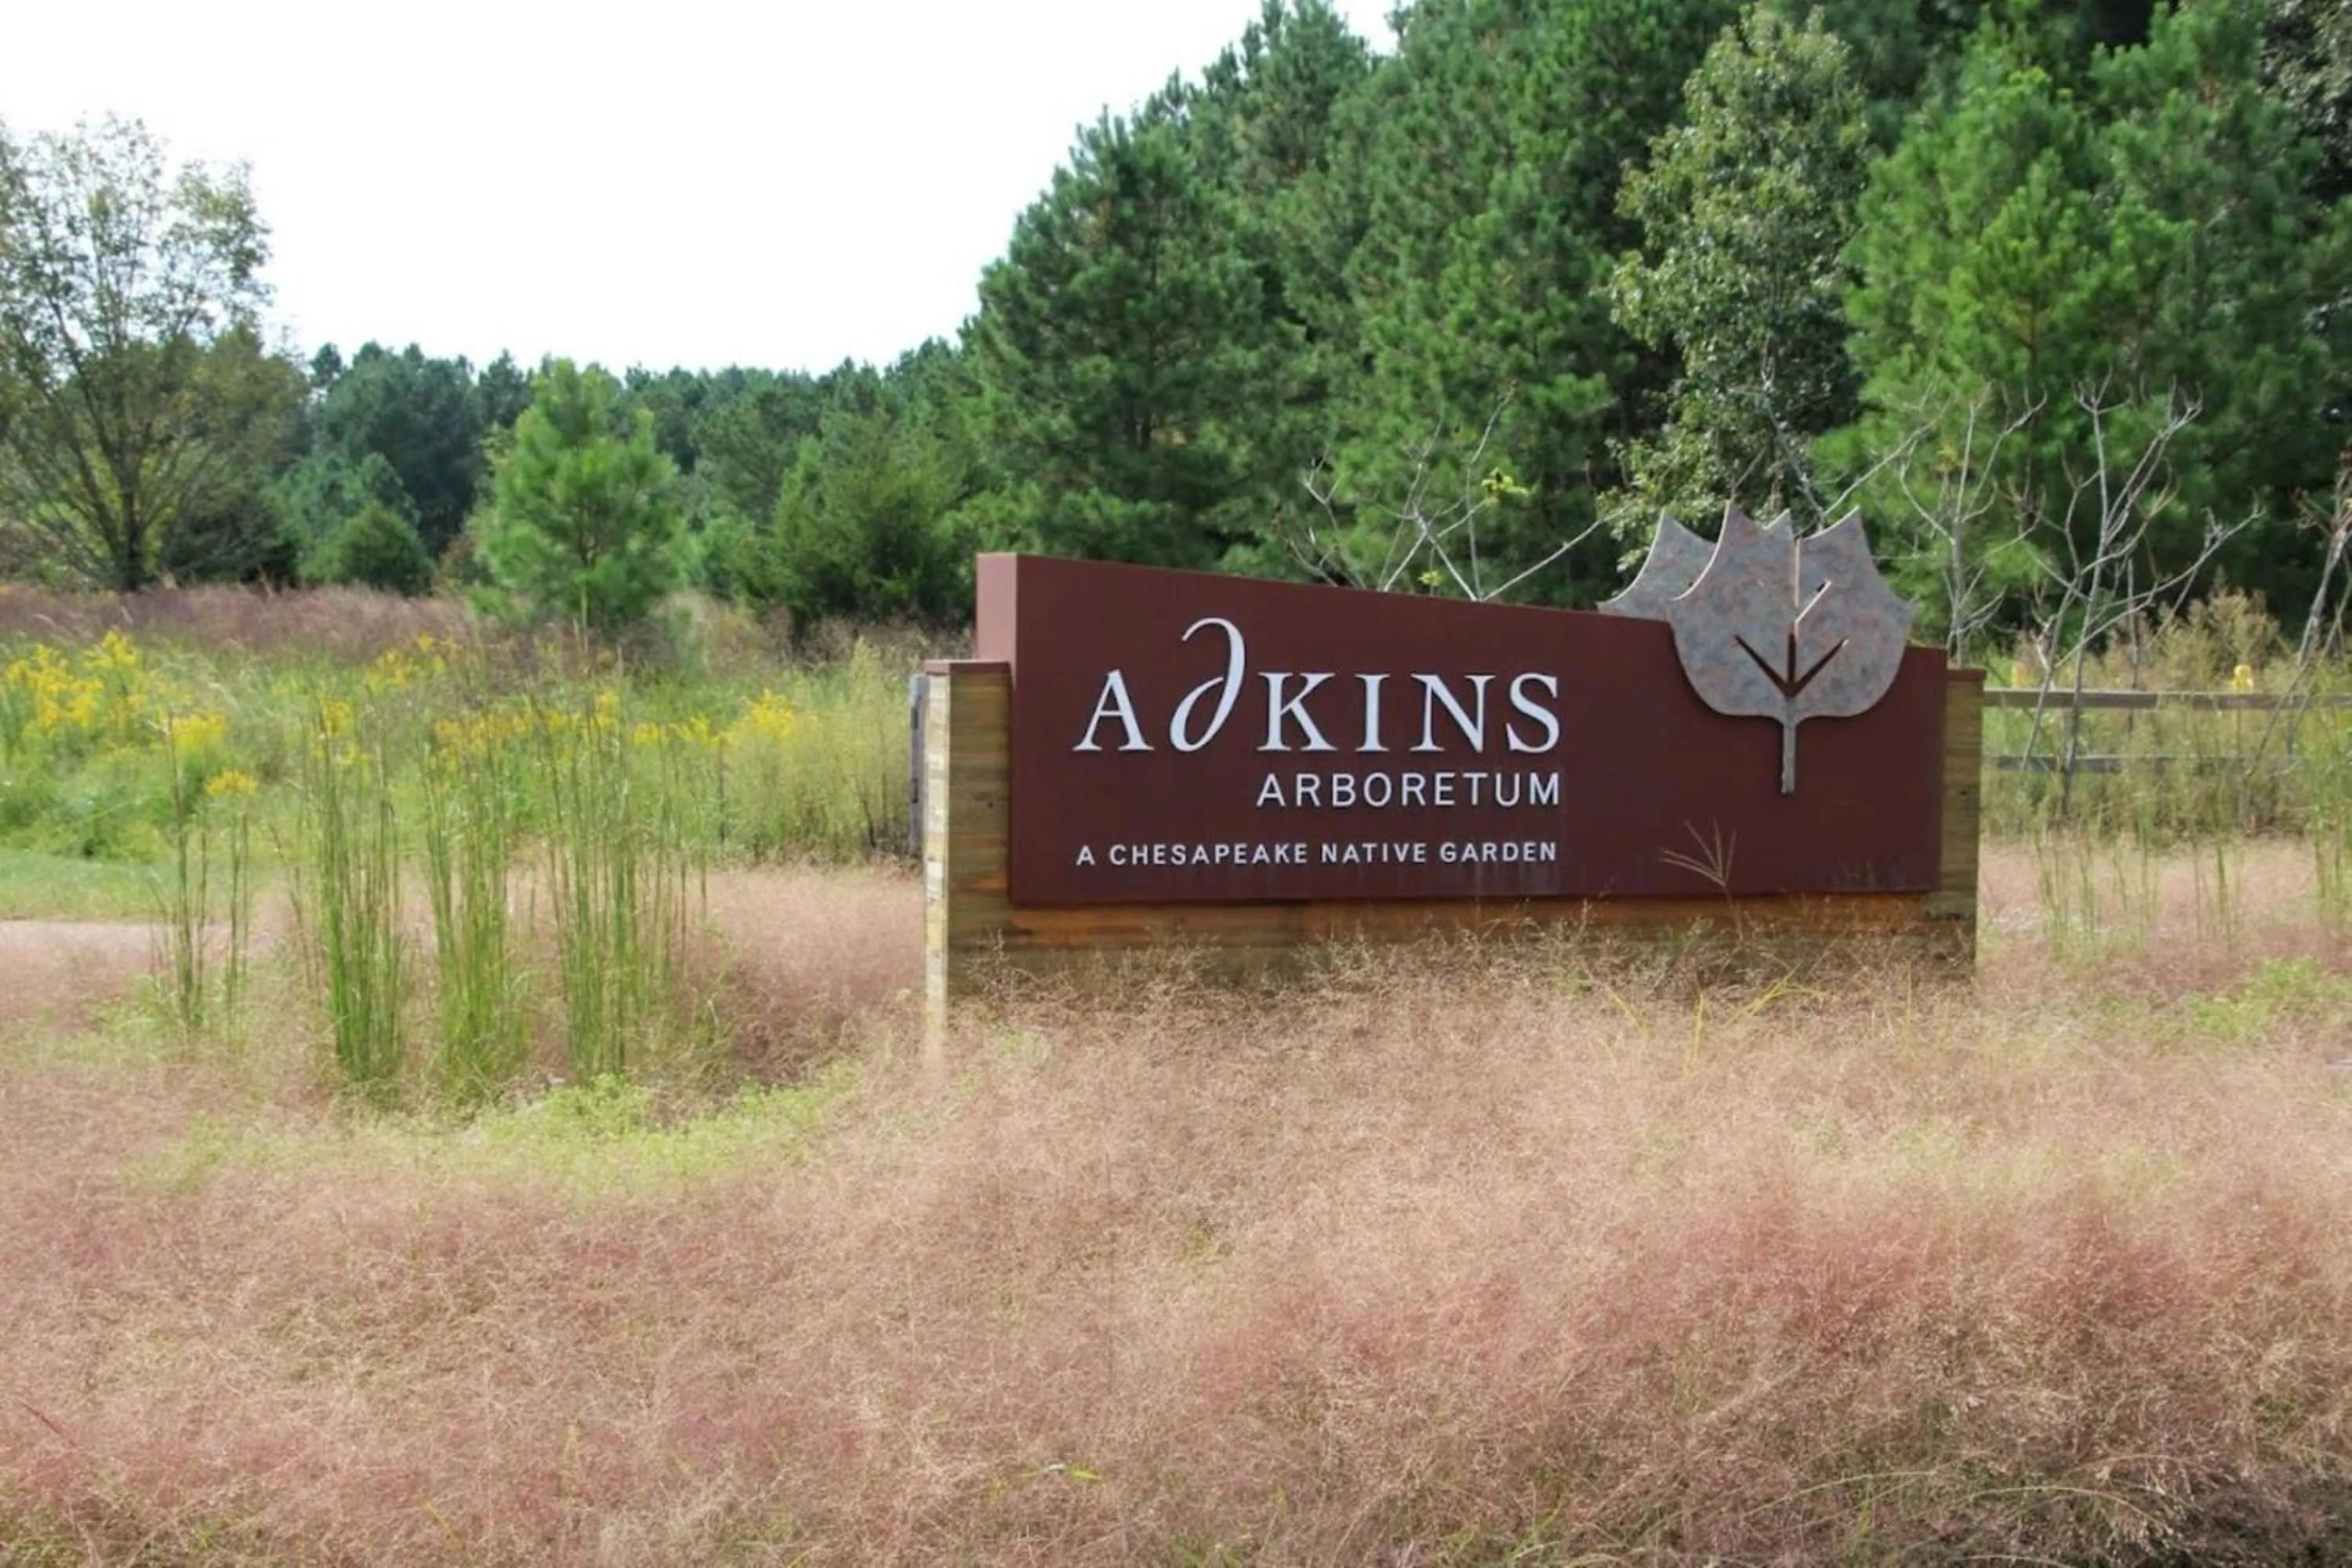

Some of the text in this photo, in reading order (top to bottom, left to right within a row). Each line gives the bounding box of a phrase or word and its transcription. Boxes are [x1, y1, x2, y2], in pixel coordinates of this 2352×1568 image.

[1255, 771, 1560, 808] ARBORETUM
[1076, 841, 1556, 866] A CHESAPEAKE NATIVE GARDEN
